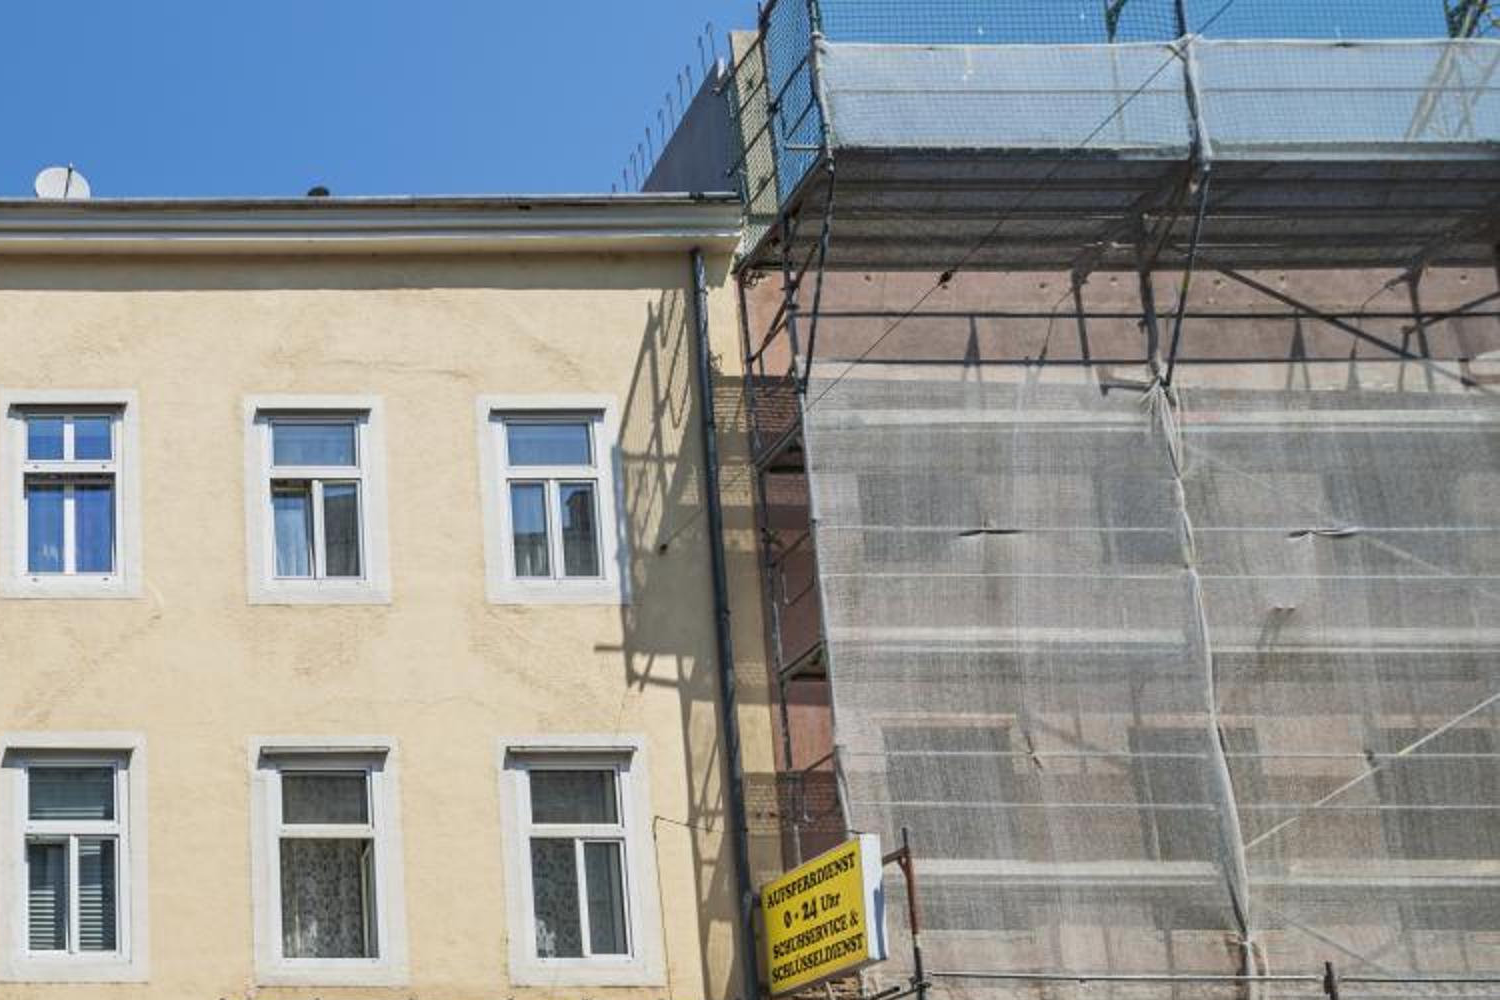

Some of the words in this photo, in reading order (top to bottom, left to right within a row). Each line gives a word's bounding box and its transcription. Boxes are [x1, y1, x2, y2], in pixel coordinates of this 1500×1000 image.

[767, 852, 856, 908] AUFSPERRDIENST
[802, 897, 818, 920] 24
[821, 893, 841, 912] Uhr
[772, 932, 864, 984] SCHLÜSSELDIENST
[773, 914, 848, 959] SCHUHSERVICE
